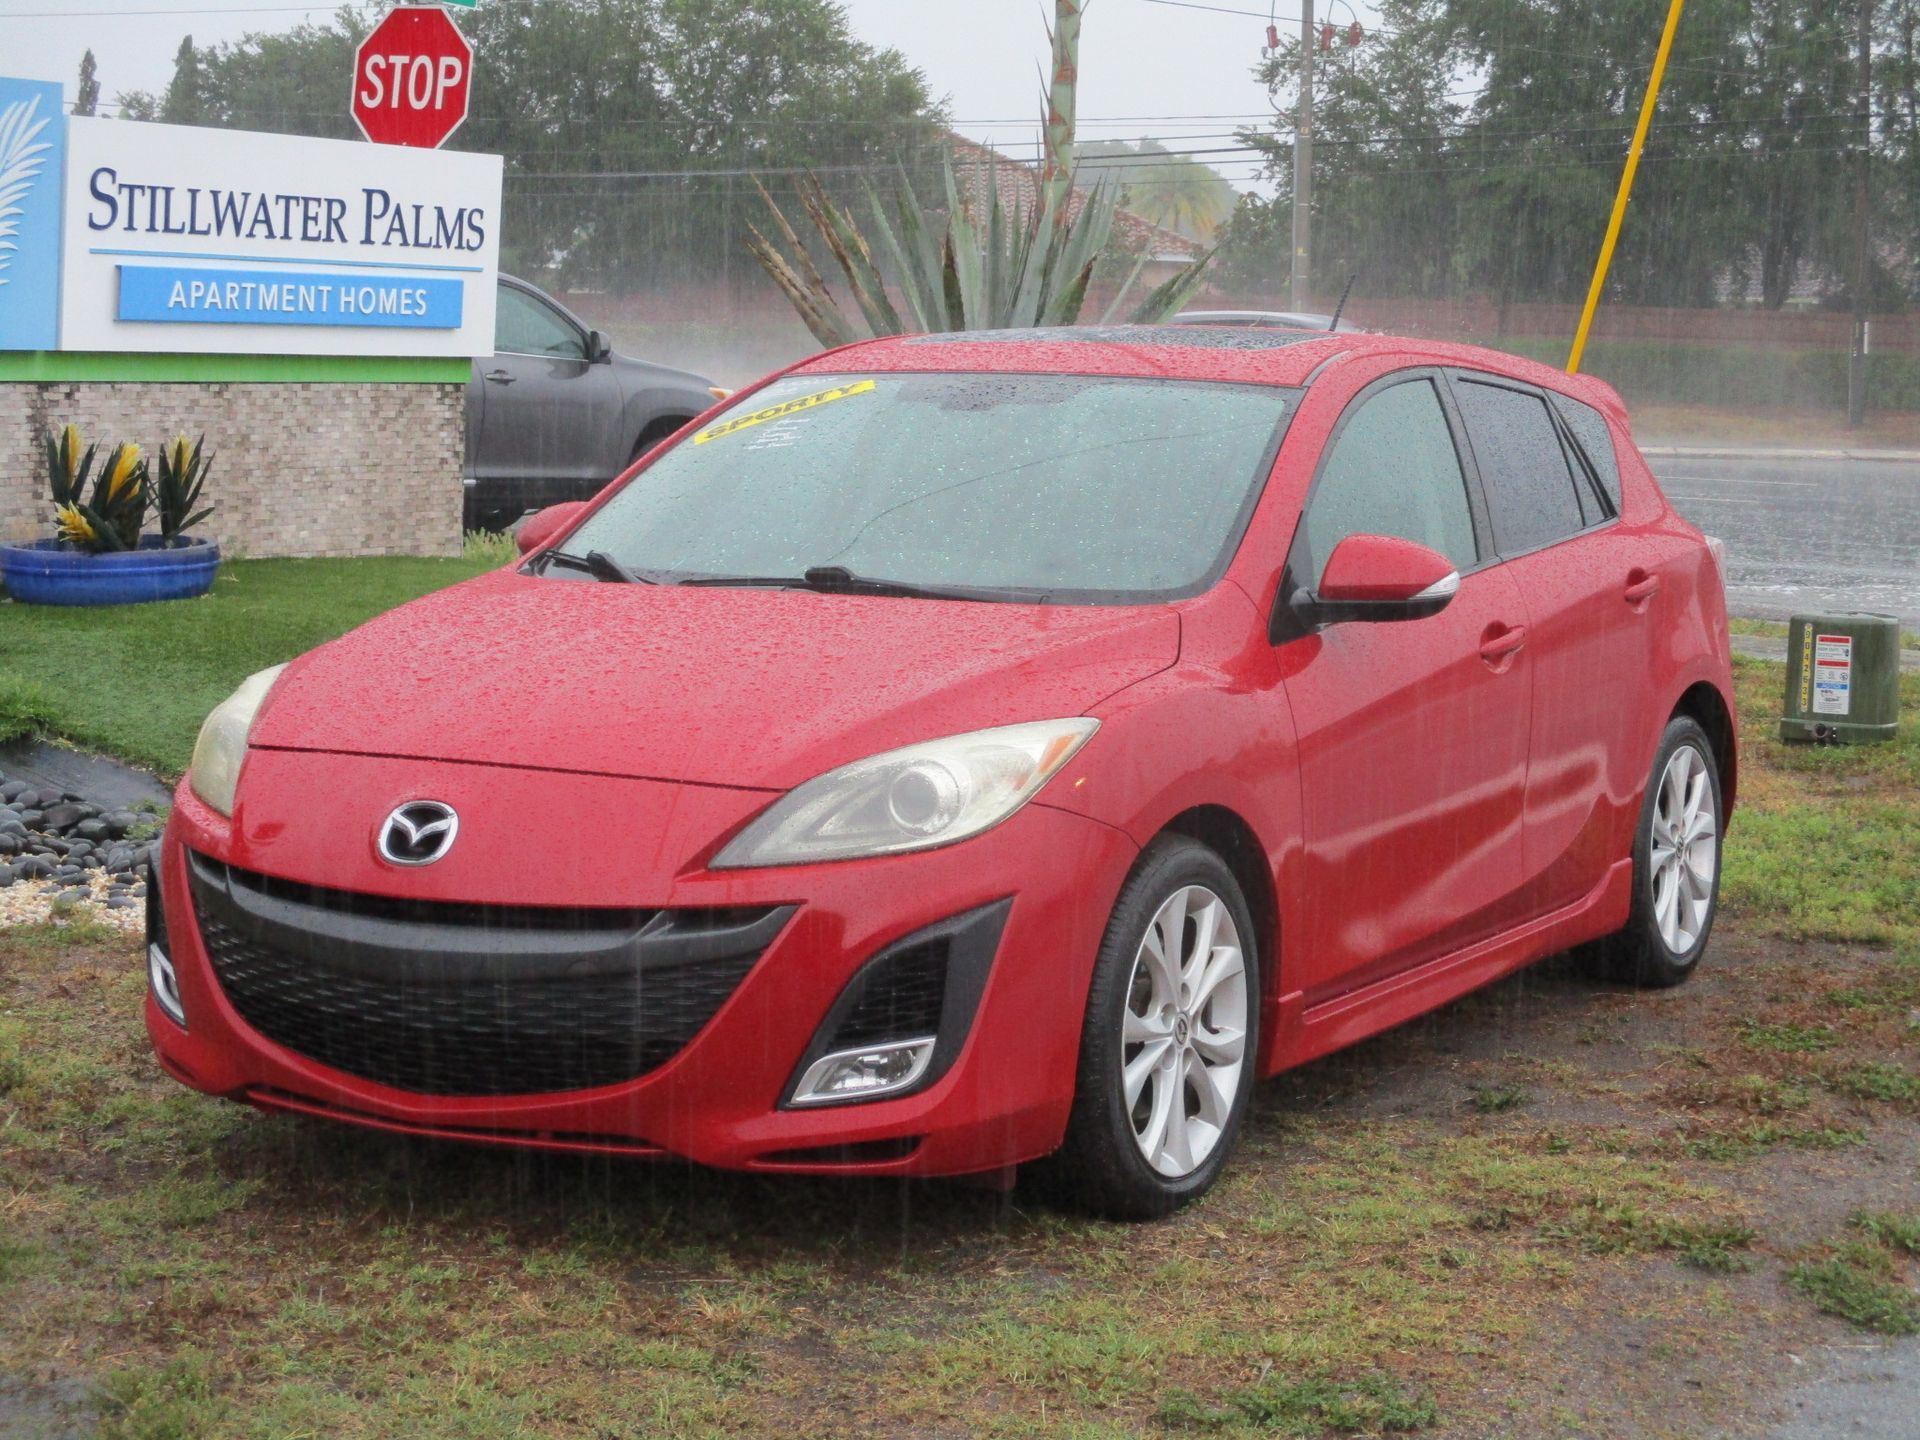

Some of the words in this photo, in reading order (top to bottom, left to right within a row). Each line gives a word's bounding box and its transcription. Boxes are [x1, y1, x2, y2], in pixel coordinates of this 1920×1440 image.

[361, 54, 462, 110] STOP
[88, 167, 348, 243] STILLWATER
[360, 188, 485, 251] PALMS
[168, 280, 332, 313] APARTMENT
[339, 286, 428, 316] HOMES
[704, 383, 861, 439] SPORTY
